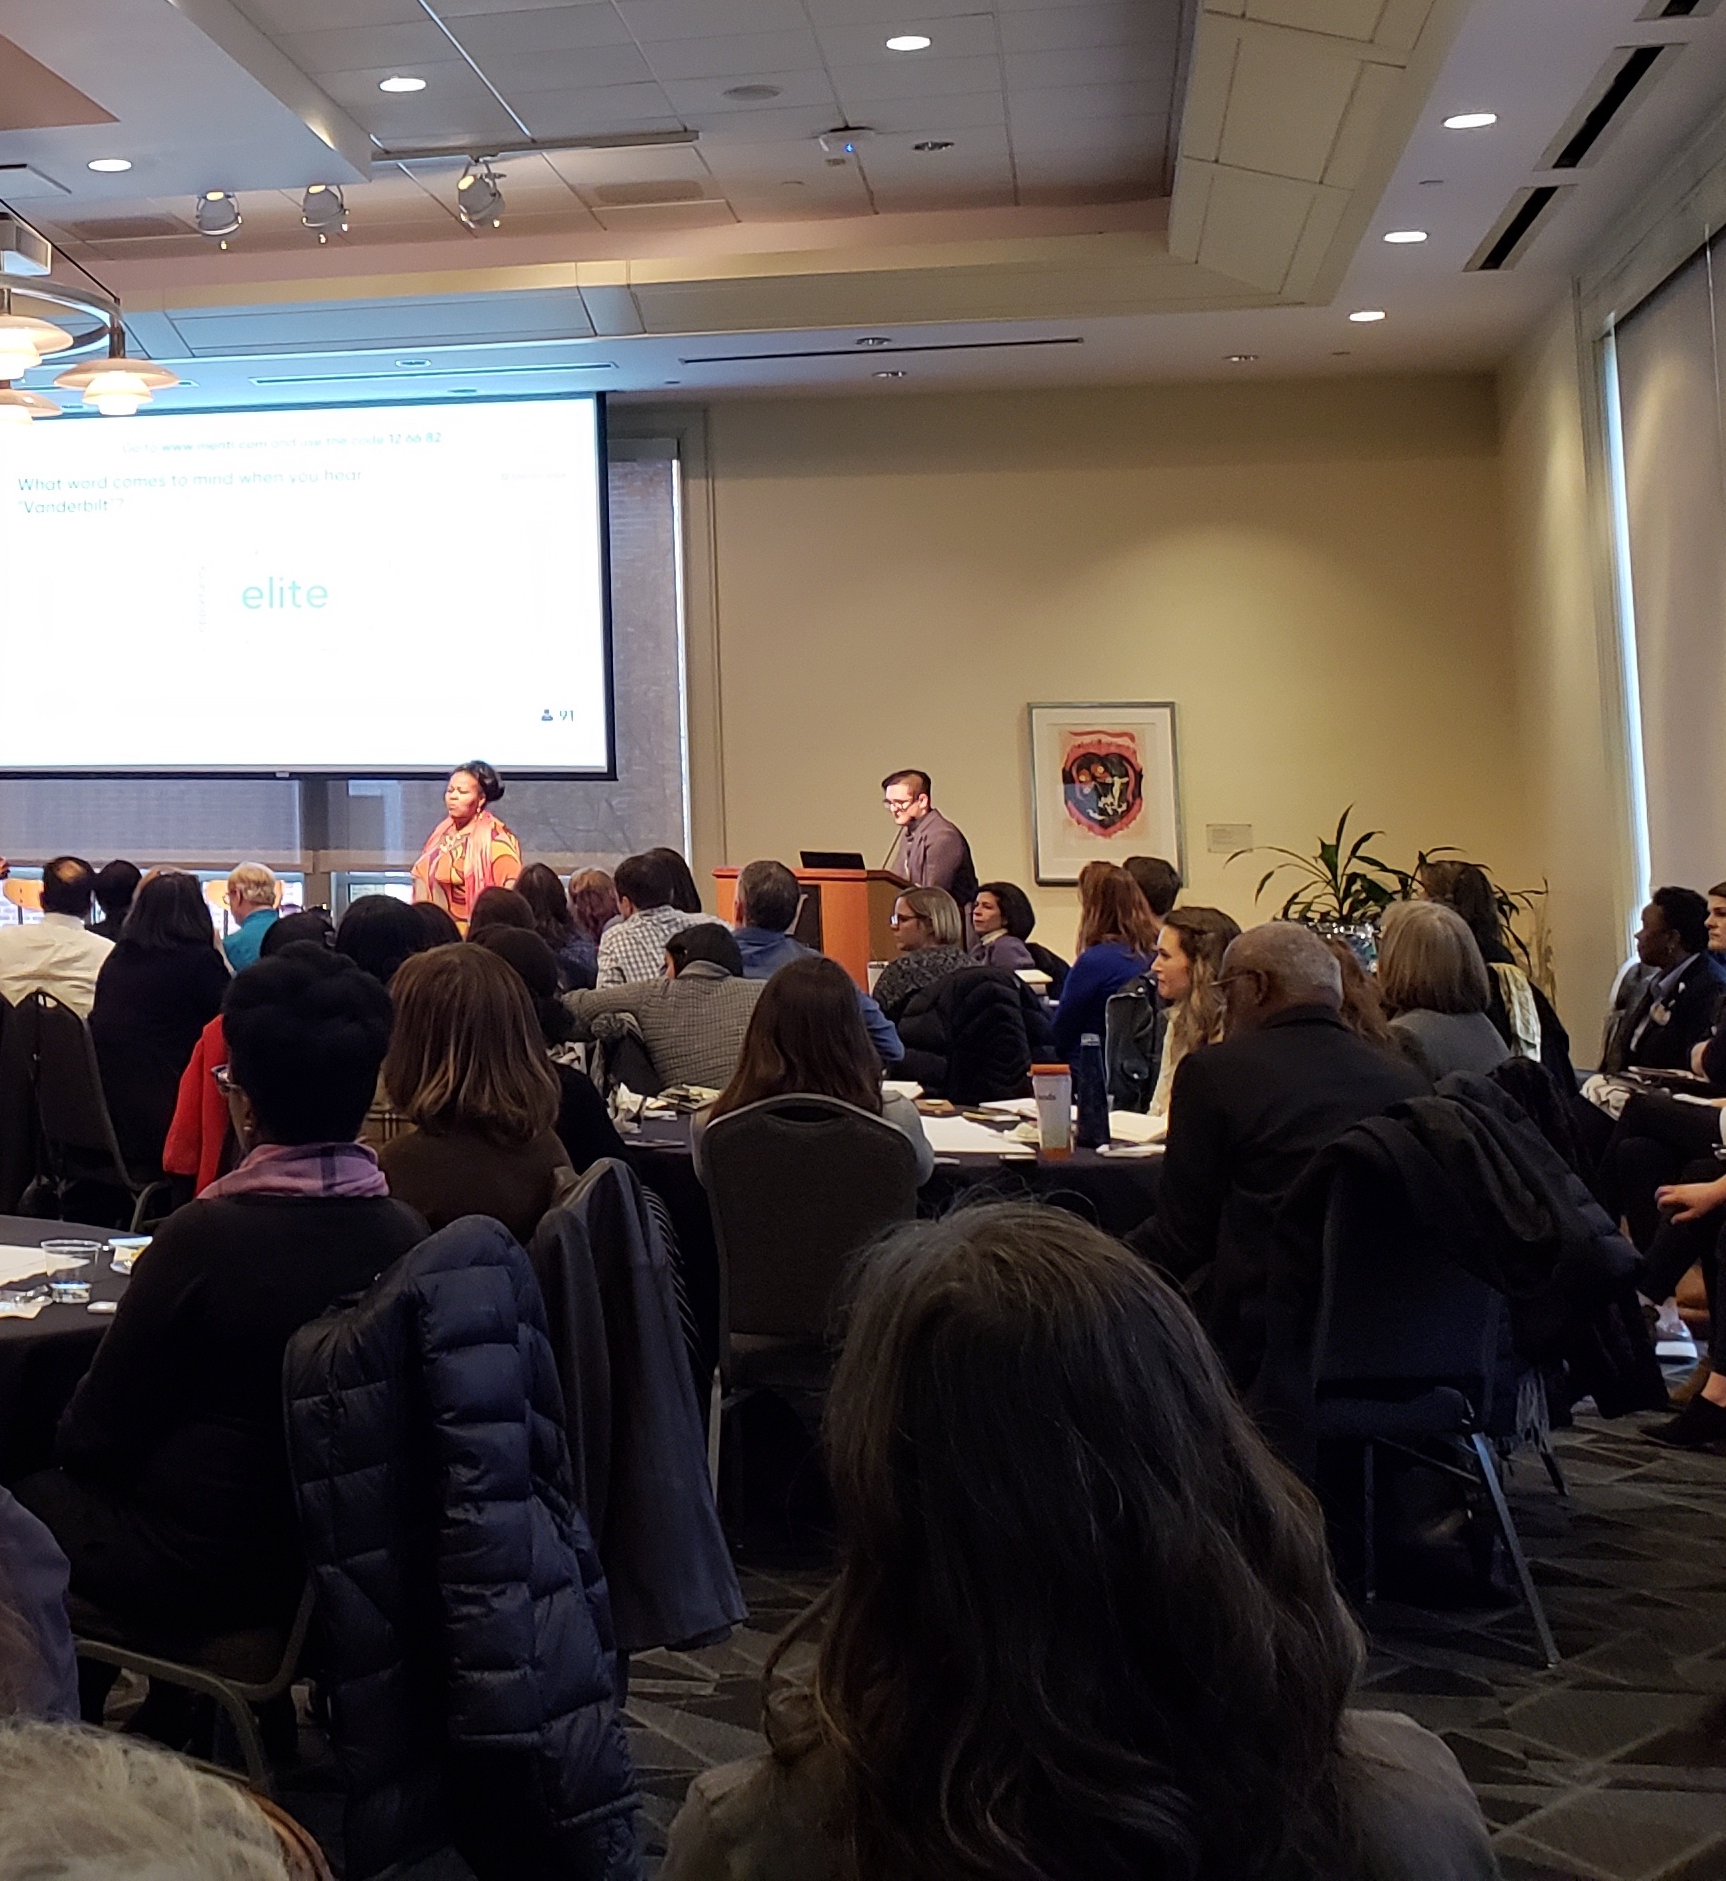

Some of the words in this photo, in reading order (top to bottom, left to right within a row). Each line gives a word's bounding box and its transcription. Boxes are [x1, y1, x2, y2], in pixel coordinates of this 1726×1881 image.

[161, 440, 267, 451] wwwmenticom
[387, 433, 401, 445] 12
[425, 432, 442, 443] 82
[17, 477, 62, 491] What
[67, 476, 108, 490] word
[112, 476, 165, 489] comes
[171, 475, 188, 488] to
[192, 471, 234, 486] mind
[239, 470, 284, 484] when
[288, 471, 319, 485] you
[324, 468, 361, 482] hear
[241, 575, 330, 610] elite
[559, 709, 574, 722] 91
